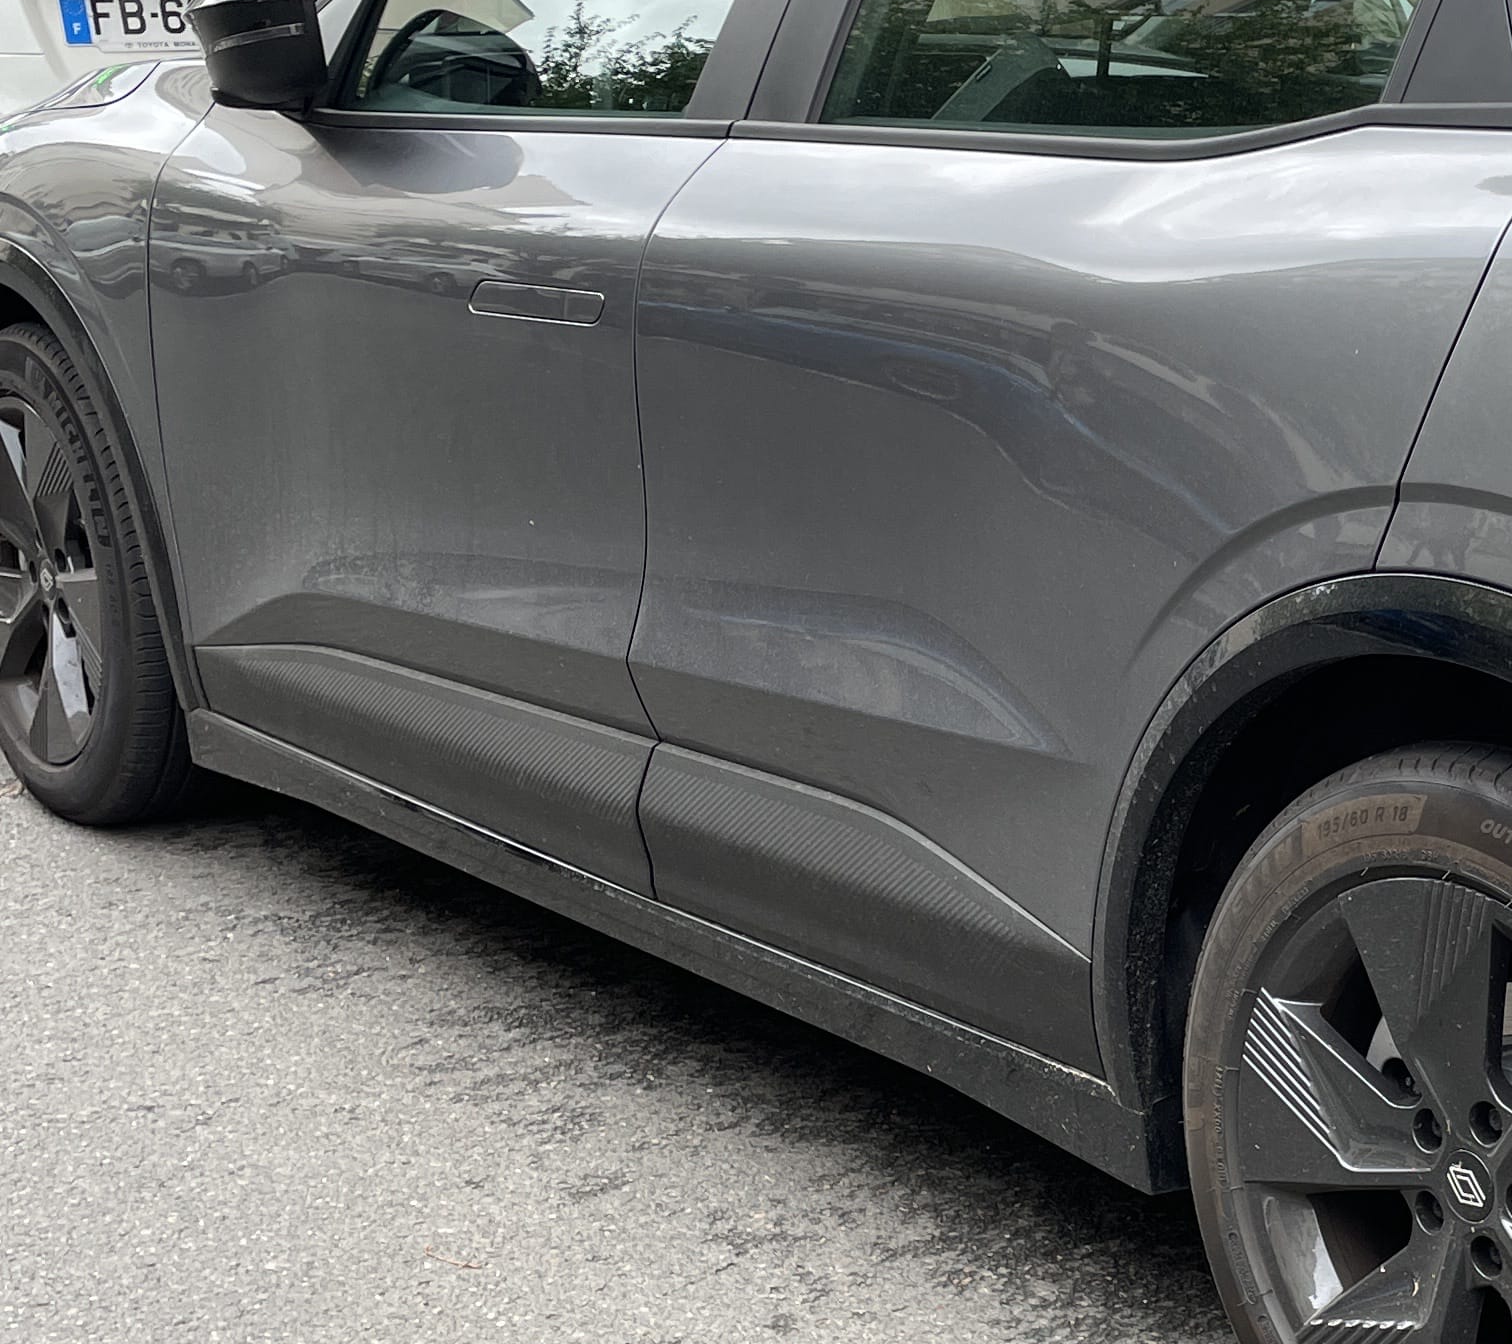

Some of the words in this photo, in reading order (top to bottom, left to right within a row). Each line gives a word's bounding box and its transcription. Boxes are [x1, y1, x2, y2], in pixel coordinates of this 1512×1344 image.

[72, 22, 82, 36] F
[1317, 809, 1369, 840] 195/60
[1374, 808, 1385, 823] R
[1392, 805, 1409, 822] 18
